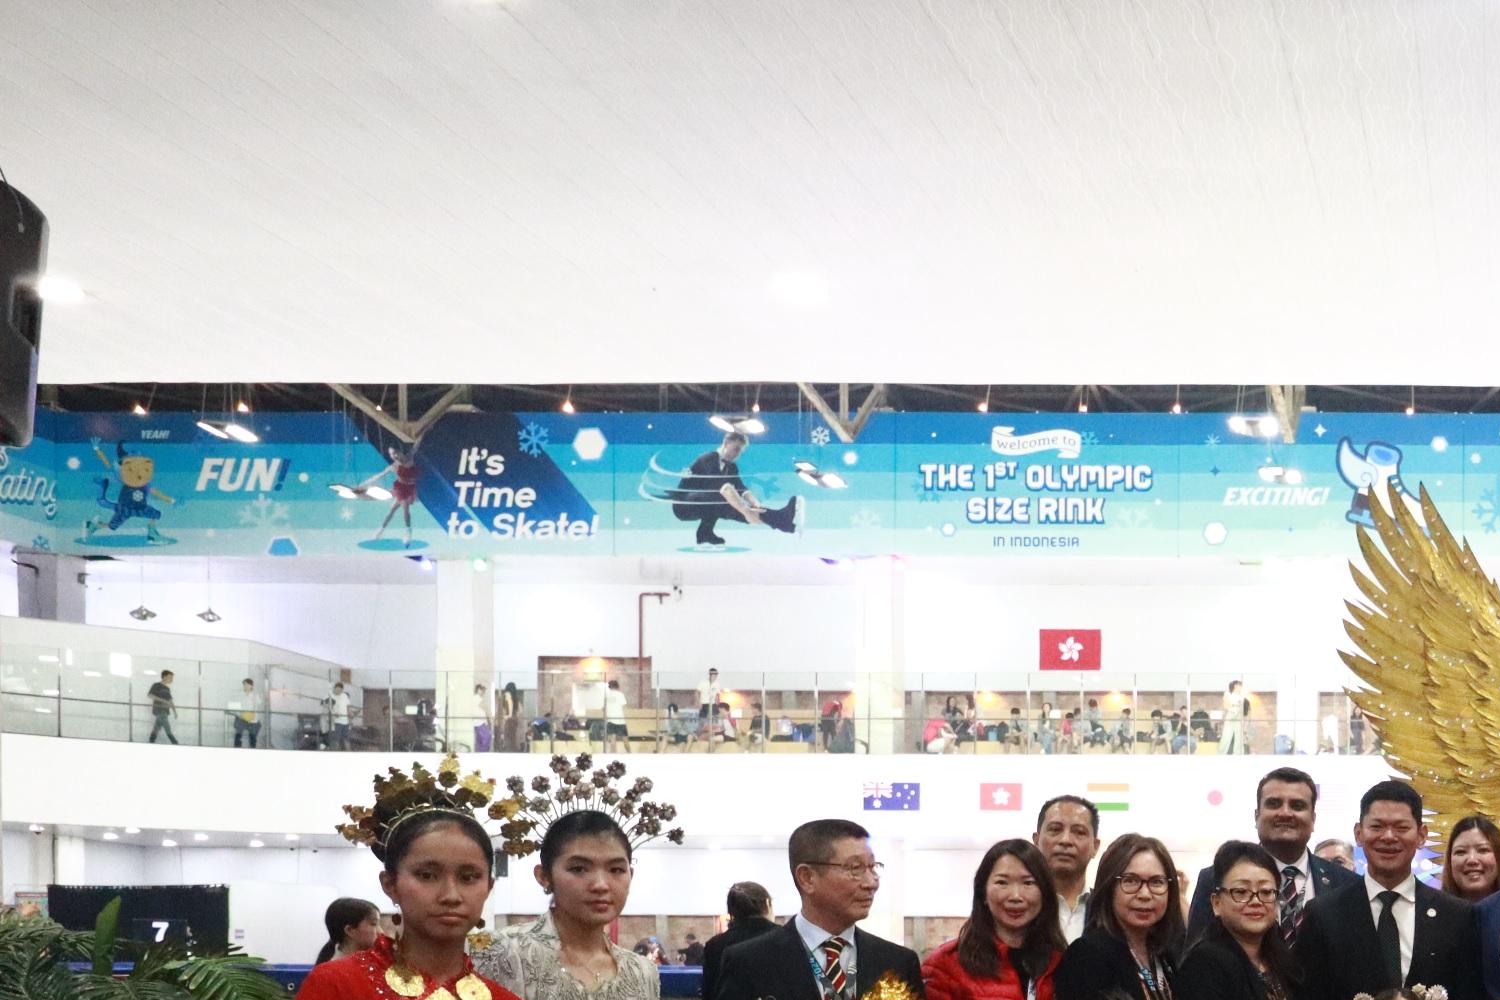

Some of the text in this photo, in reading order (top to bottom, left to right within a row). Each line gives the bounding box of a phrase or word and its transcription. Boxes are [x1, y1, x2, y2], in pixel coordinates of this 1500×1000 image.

[141, 430, 170, 439] YEAH!
[997, 436, 1076, 449] welcome to
[195, 457, 291, 492] FUN!
[458, 447, 505, 475] It's
[920, 461, 1152, 491] THE 1ST OLYMPIC
[454, 481, 537, 508] Time
[1223, 486, 1330, 506] EXCITING!
[967, 497, 1105, 524] SIZE RINK
[447, 512, 600, 541] to Skate!
[993, 537, 1080, 547] IN INDONESIA
[151, 921, 169, 943] 7
